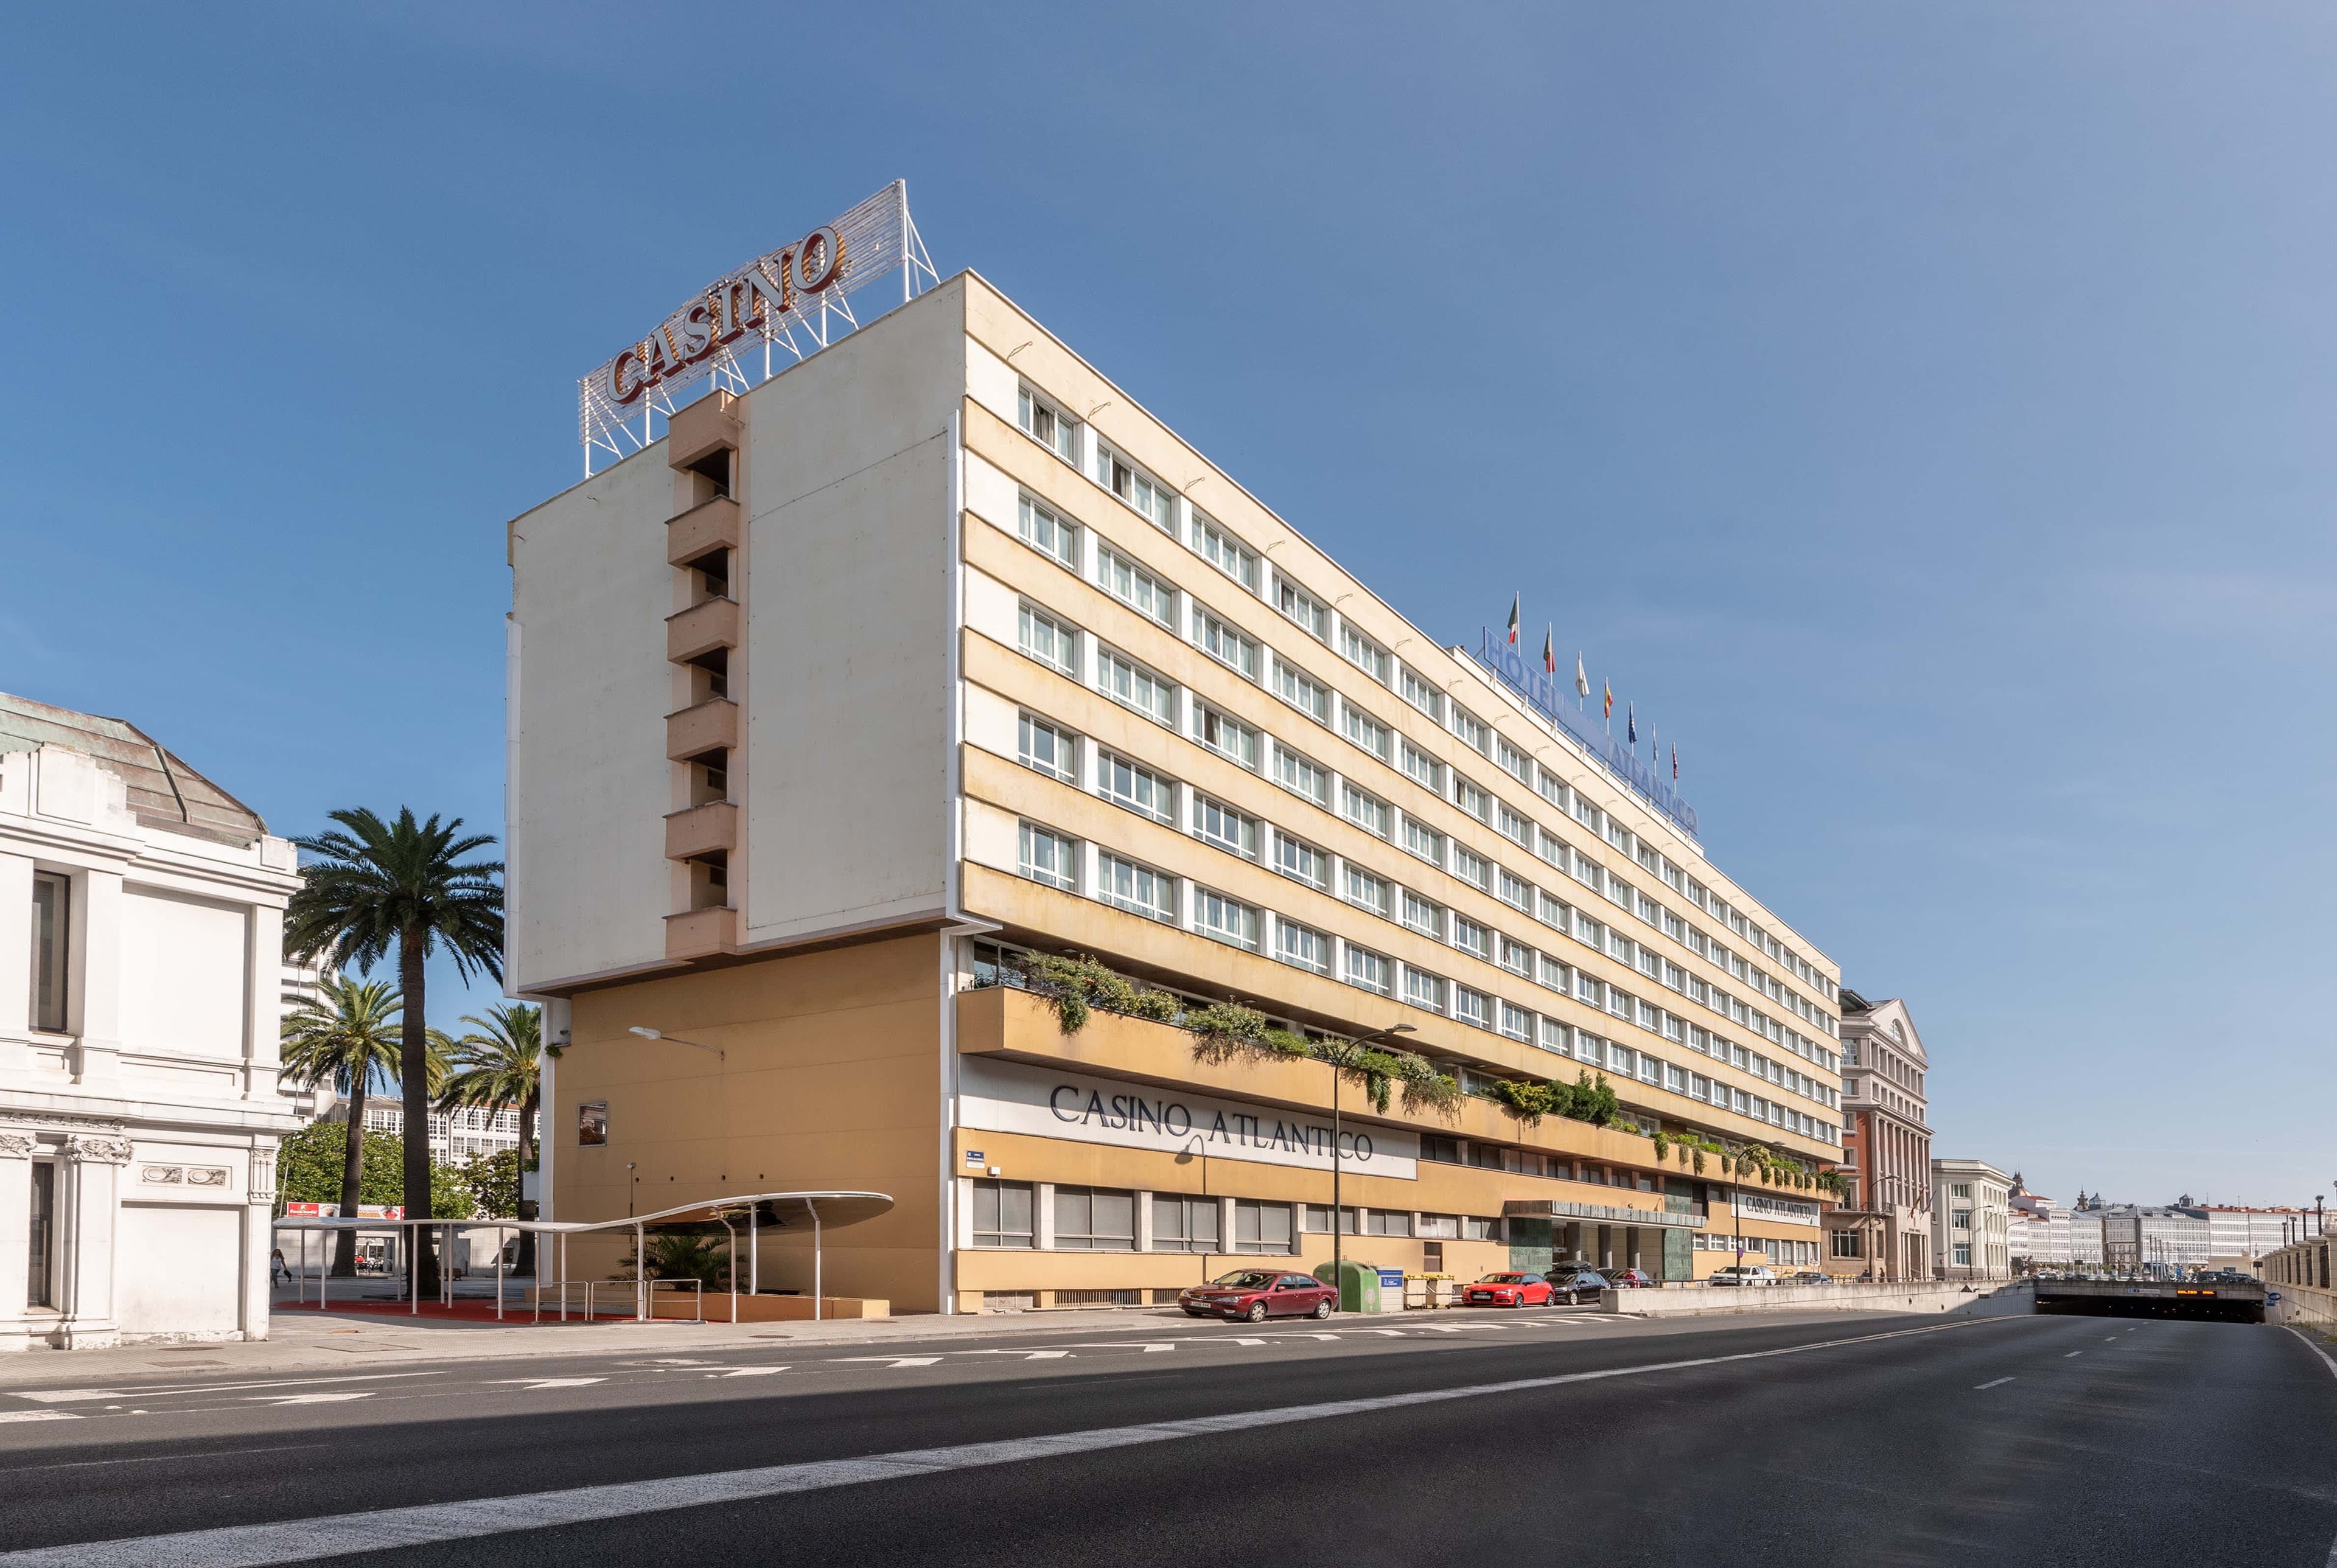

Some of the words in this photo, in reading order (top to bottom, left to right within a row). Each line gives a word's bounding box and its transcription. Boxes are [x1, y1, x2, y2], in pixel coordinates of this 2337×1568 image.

[607, 226, 847, 404] CASINO
[1487, 632, 1561, 718] HOTEL
[1050, 1085, 1192, 1137] CASINO
[1208, 1110, 1374, 1162] ATLANTICO
[1745, 1196, 1772, 1214] CASINO
[1774, 1200, 1811, 1219] ATLANTICO
